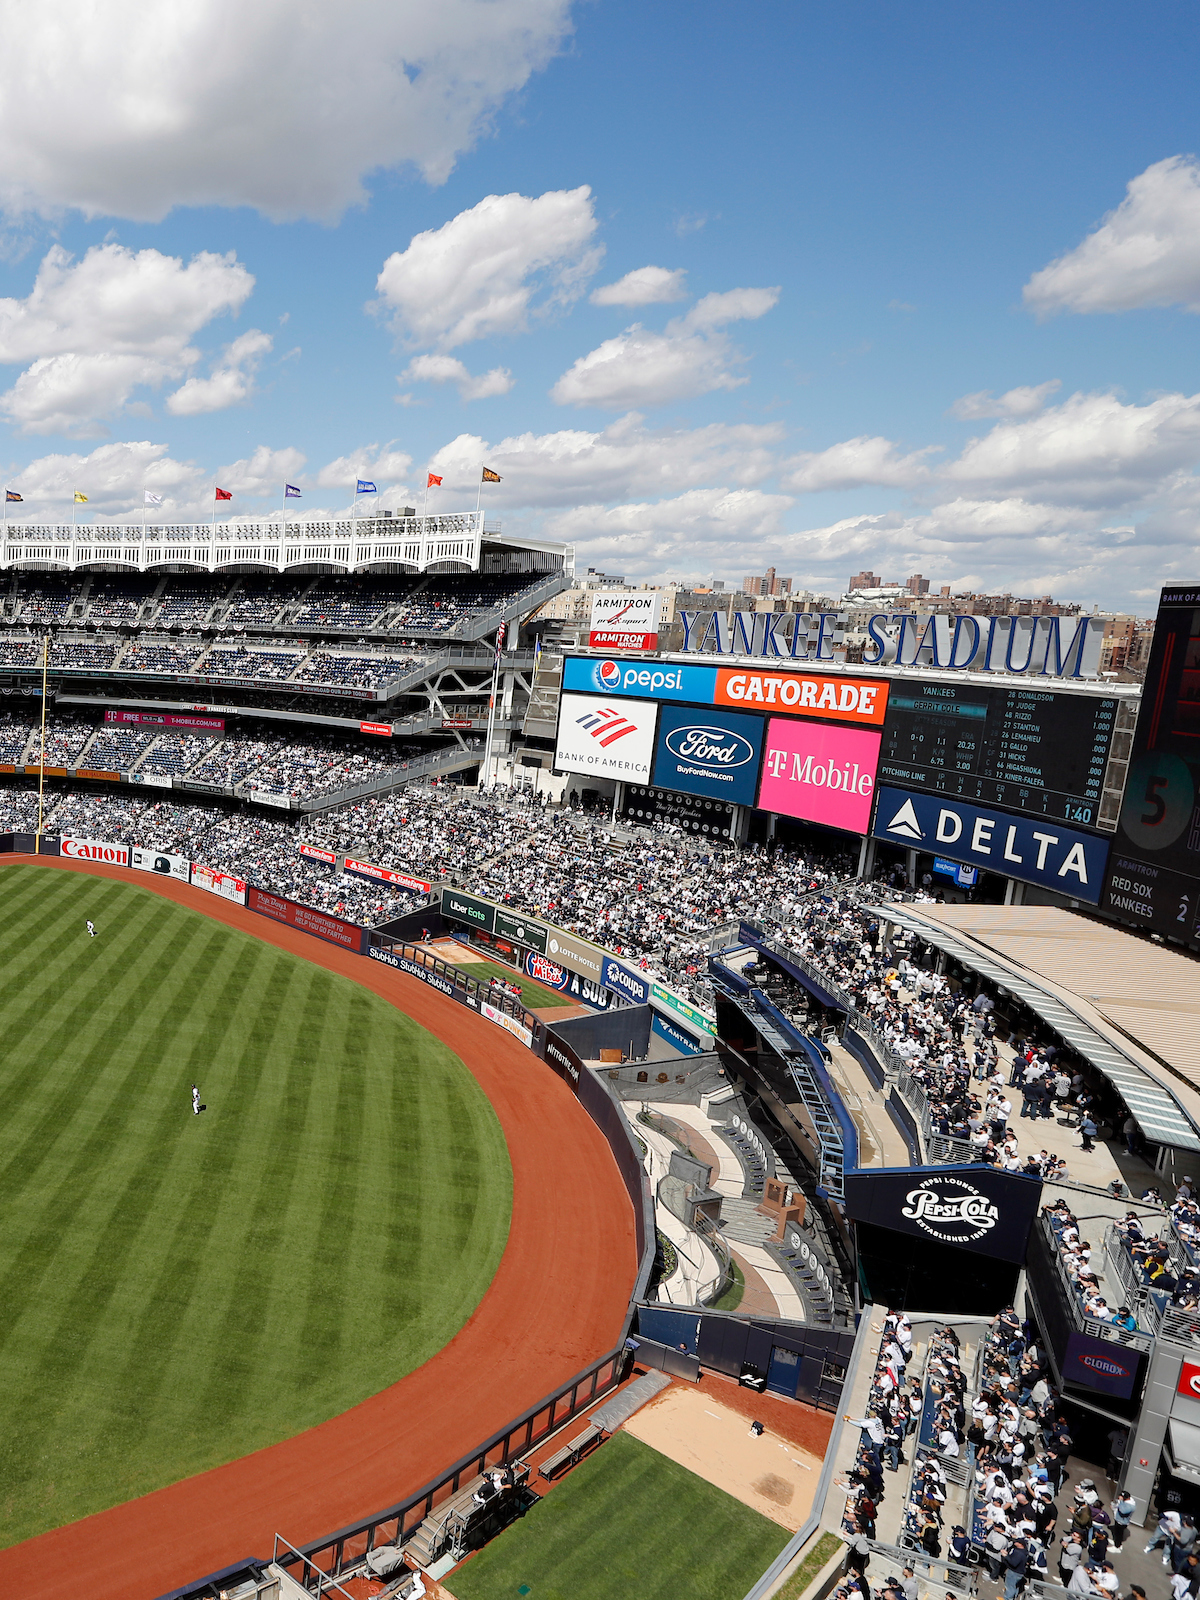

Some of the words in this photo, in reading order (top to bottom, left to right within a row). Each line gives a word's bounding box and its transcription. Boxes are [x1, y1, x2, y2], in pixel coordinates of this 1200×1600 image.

[596, 600, 652, 608] ARMITRON
[594, 632, 646, 642] ARMITRON
[676, 610, 848, 660] YANKEE
[862, 614, 1105, 678] STADIUM
[623, 666, 682, 691] pepsi
[726, 676, 878, 714] GATORADE
[923, 686, 956, 698] YANKEES
[1018, 692, 1054, 702] DONALDSON
[1100, 700, 1114, 708] .000
[914, 701, 940, 711] GERRIT
[942, 704, 960, 714] COLE
[1016, 702, 1036, 711] JUDGE
[1095, 711, 1112, 720] 1.000
[171, 718, 221, 727] T-MOBILE.COM/MLB
[1013, 722, 1040, 732] STANTON
[1094, 734, 1108, 742] .000
[1015, 712, 1032, 721] RIZZO
[1093, 722, 1110, 731] 1.000
[680, 729, 736, 763] Ford
[957, 740, 975, 750] 20.25
[1010, 742, 1028, 752] GALLO
[1090, 756, 1104, 764] .000
[1012, 733, 1041, 743] LEMAHIEU
[1092, 745, 1106, 753] .000
[558, 751, 585, 764] BANK
[587, 755, 600, 765] OF
[600, 757, 648, 774] AMERICA
[930, 757, 944, 765] 6.75
[956, 761, 970, 770] 3.00
[1008, 753, 1026, 762] HICKS
[1088, 767, 1102, 776] .000
[677, 765, 733, 782] BuyFordNow.com
[791, 752, 873, 796] Mobile
[882, 766, 910, 778] PITCHING
[911, 772, 926, 781] LINE
[1006, 761, 1042, 775] HIGASHIOKA
[1086, 778, 1100, 787] .000
[957, 785, 962, 793] 3
[997, 794, 1002, 802] 3
[1005, 772, 1045, 787] KINER-FALEFA
[1084, 789, 1098, 798] .000
[253, 793, 269, 802] Poland
[270, 796, 288, 808] Spring
[656, 802, 666, 810] New
[666, 804, 680, 814] York
[680, 807, 701, 818] Yankees
[1141, 776, 1168, 826] 5
[1064, 803, 1092, 824] 1:40
[62, 840, 127, 864] Canon
[310, 849, 333, 862] StateFarm
[936, 808, 1089, 884] DELTA
[357, 864, 382, 877] StateFarm
[1116, 860, 1158, 878] ARMITRON
[397, 875, 424, 891] StateFarm
[1112, 875, 1131, 891] RED
[1132, 882, 1153, 898] SOX
[270, 897, 287, 911] Boys
[450, 900, 468, 914] Uber
[468, 907, 485, 921] Eats
[1110, 893, 1154, 918] YANKEES
[1176, 903, 1188, 922] 2
[295, 917, 308, 926] HELP
[309, 922, 319, 930] YOU
[319, 926, 327, 934] GO
[327, 928, 352, 943] FARTHER
[296, 908, 304, 916] WE
[304, 912, 312, 920] GO
[312, 915, 336, 929] FURTHER
[336, 924, 344, 932] TO
[560, 947, 578, 960] LOTTE
[578, 957, 600, 972] HOTELS
[370, 948, 398, 966] StubHub
[400, 960, 426, 980] StubHub
[427, 974, 452, 995] StubHub
[570, 974, 580, 994] A
[582, 978, 607, 1007] SUB
[619, 970, 644, 998] coupa
[668, 1028, 699, 1054] AMTRAK
[919, 1177, 942, 1189] PEPSI
[944, 1177, 979, 1195] LOUNGE
[916, 1219, 969, 1242] ESTABLISHED
[1084, 1357, 1123, 1375] CLOROX
